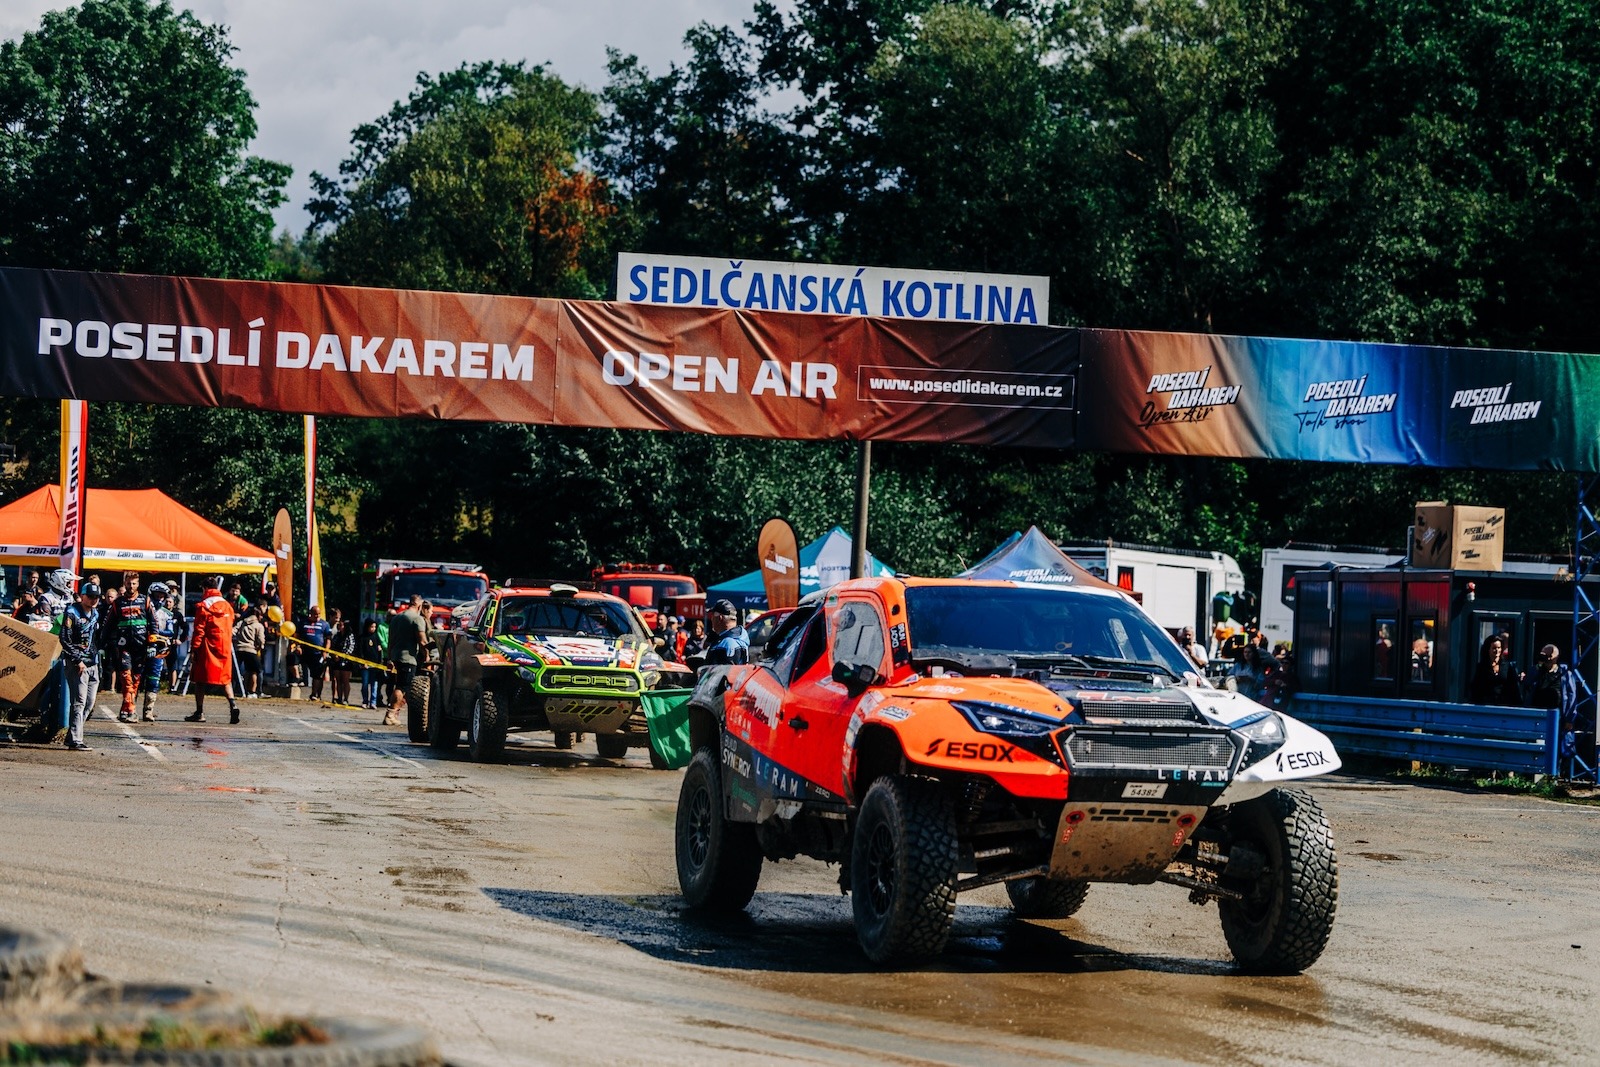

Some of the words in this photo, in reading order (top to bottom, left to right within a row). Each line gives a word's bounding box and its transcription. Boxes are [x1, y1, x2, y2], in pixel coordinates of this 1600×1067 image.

[629, 260, 869, 315] SEDLČANSKÁ
[882, 279, 1038, 324] KOTLINA
[38, 316, 265, 366] POSEDLÍ
[275, 331, 535, 382] DAKAREM
[602, 350, 739, 394] OPEN
[750, 360, 838, 399] AIR
[869, 377, 1063, 397] www.posedlidakarem.cz
[1167, 385, 1242, 410] DAKAREM
[1324, 393, 1397, 419] DAKAREM
[1470, 400, 1542, 425] DAKAREM
[26, 546, 61, 555] can-a
[117, 550, 144, 559] can-am
[154, 552, 180, 560] can-am
[551, 674, 630, 688] FORD
[722, 747, 752, 779] SYNERGY
[945, 742, 1016, 764] ESOX
[1286, 750, 1331, 770] ESOX
[755, 756, 799, 798] LERAM
[1157, 768, 1229, 782] LERAM
[1130, 788, 1158, 797] 54382
